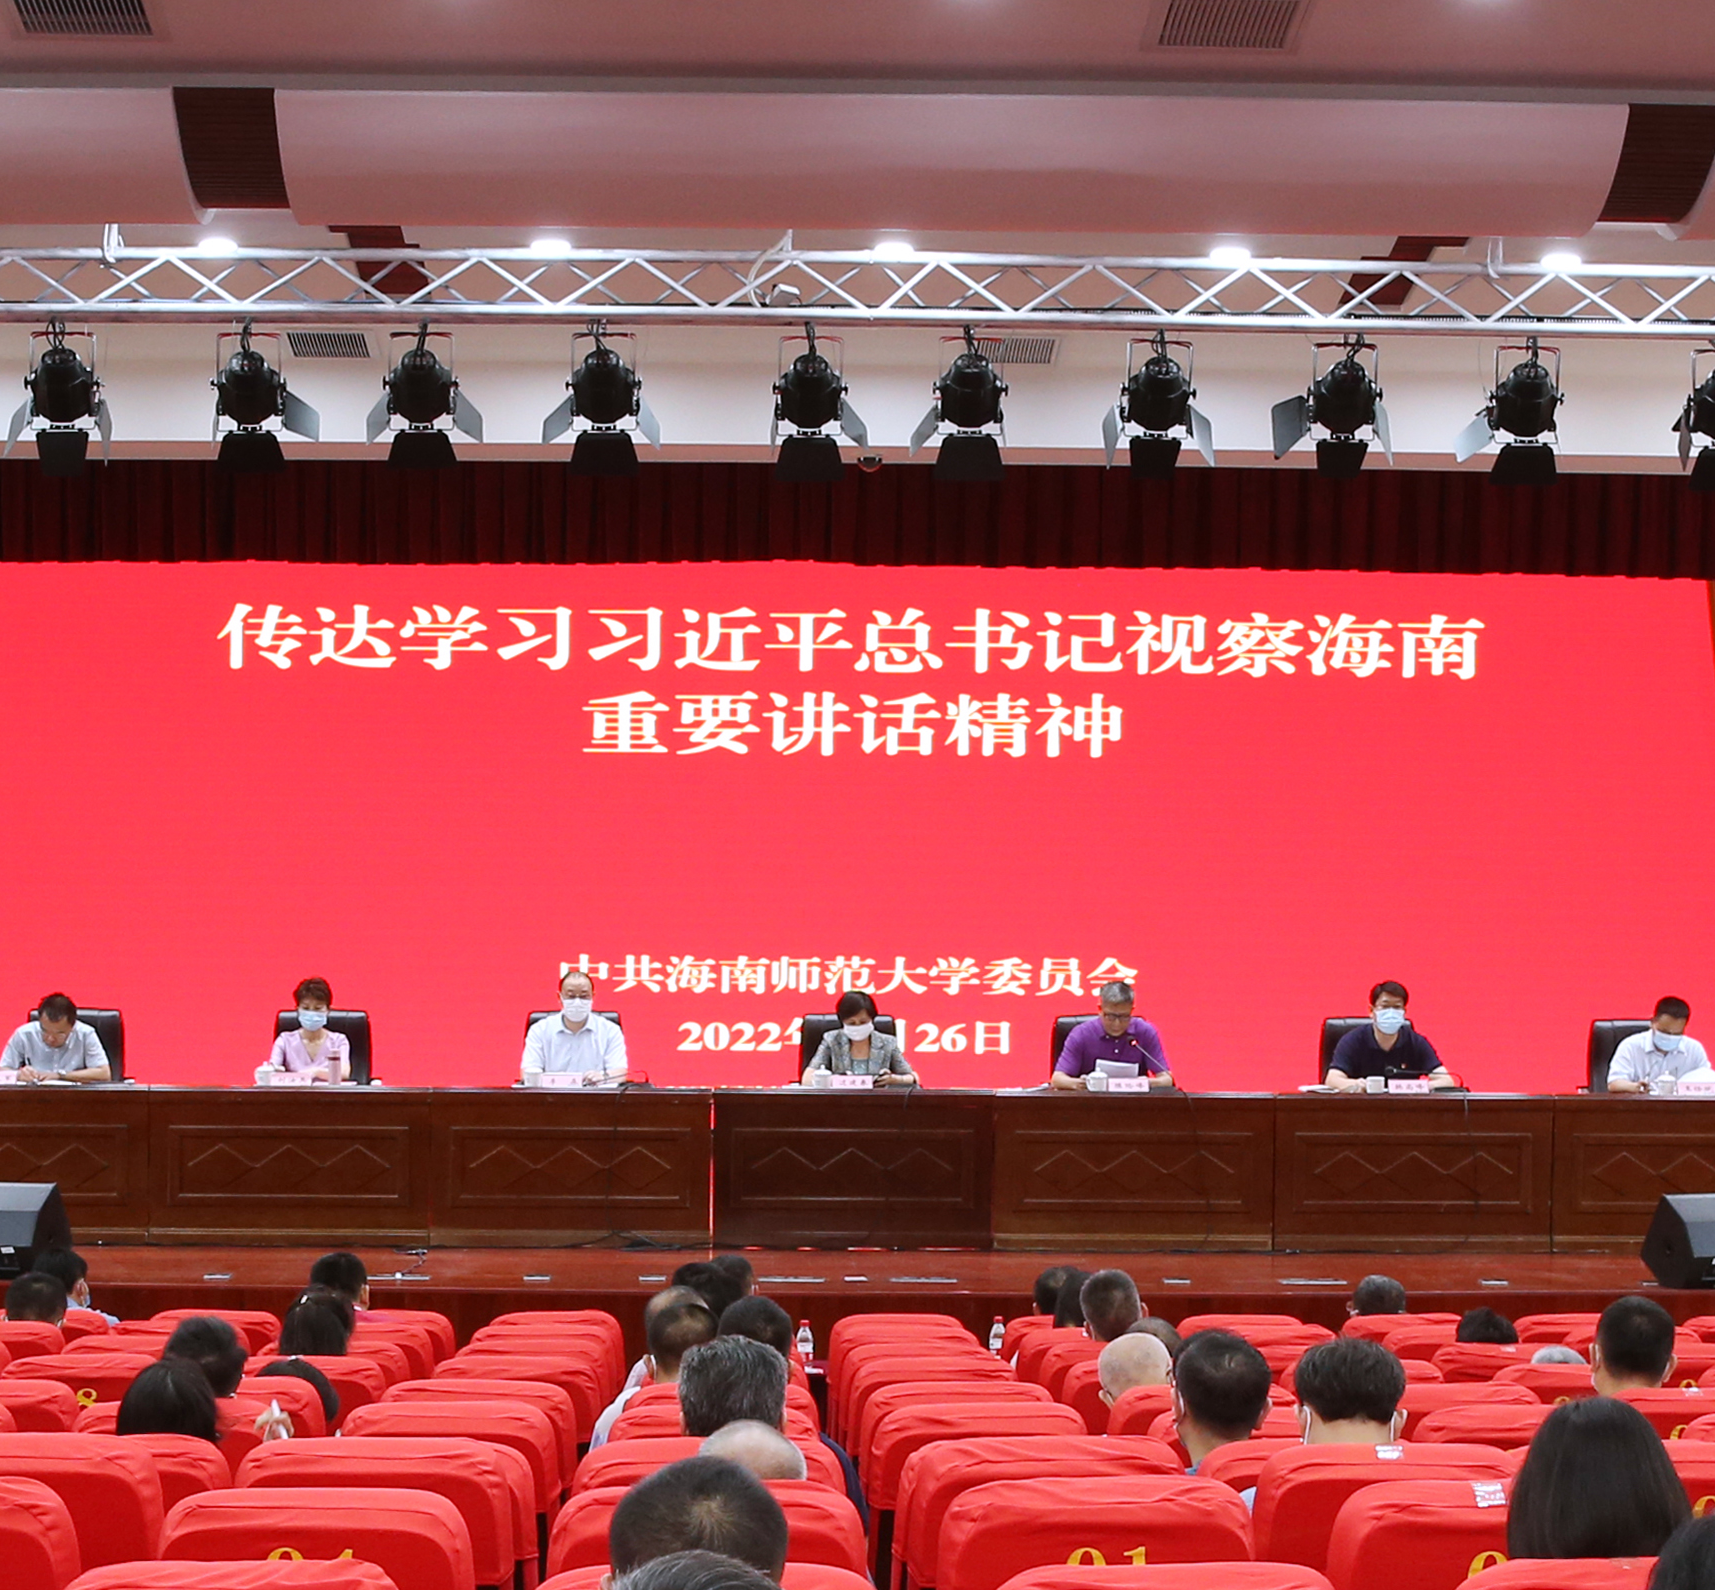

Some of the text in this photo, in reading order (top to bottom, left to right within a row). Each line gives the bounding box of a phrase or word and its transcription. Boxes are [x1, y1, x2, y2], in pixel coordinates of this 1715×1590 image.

[216, 602, 1486, 681] 传达学习习近平总书记视察海南
[581, 690, 1124, 759] 重要讲话精神
